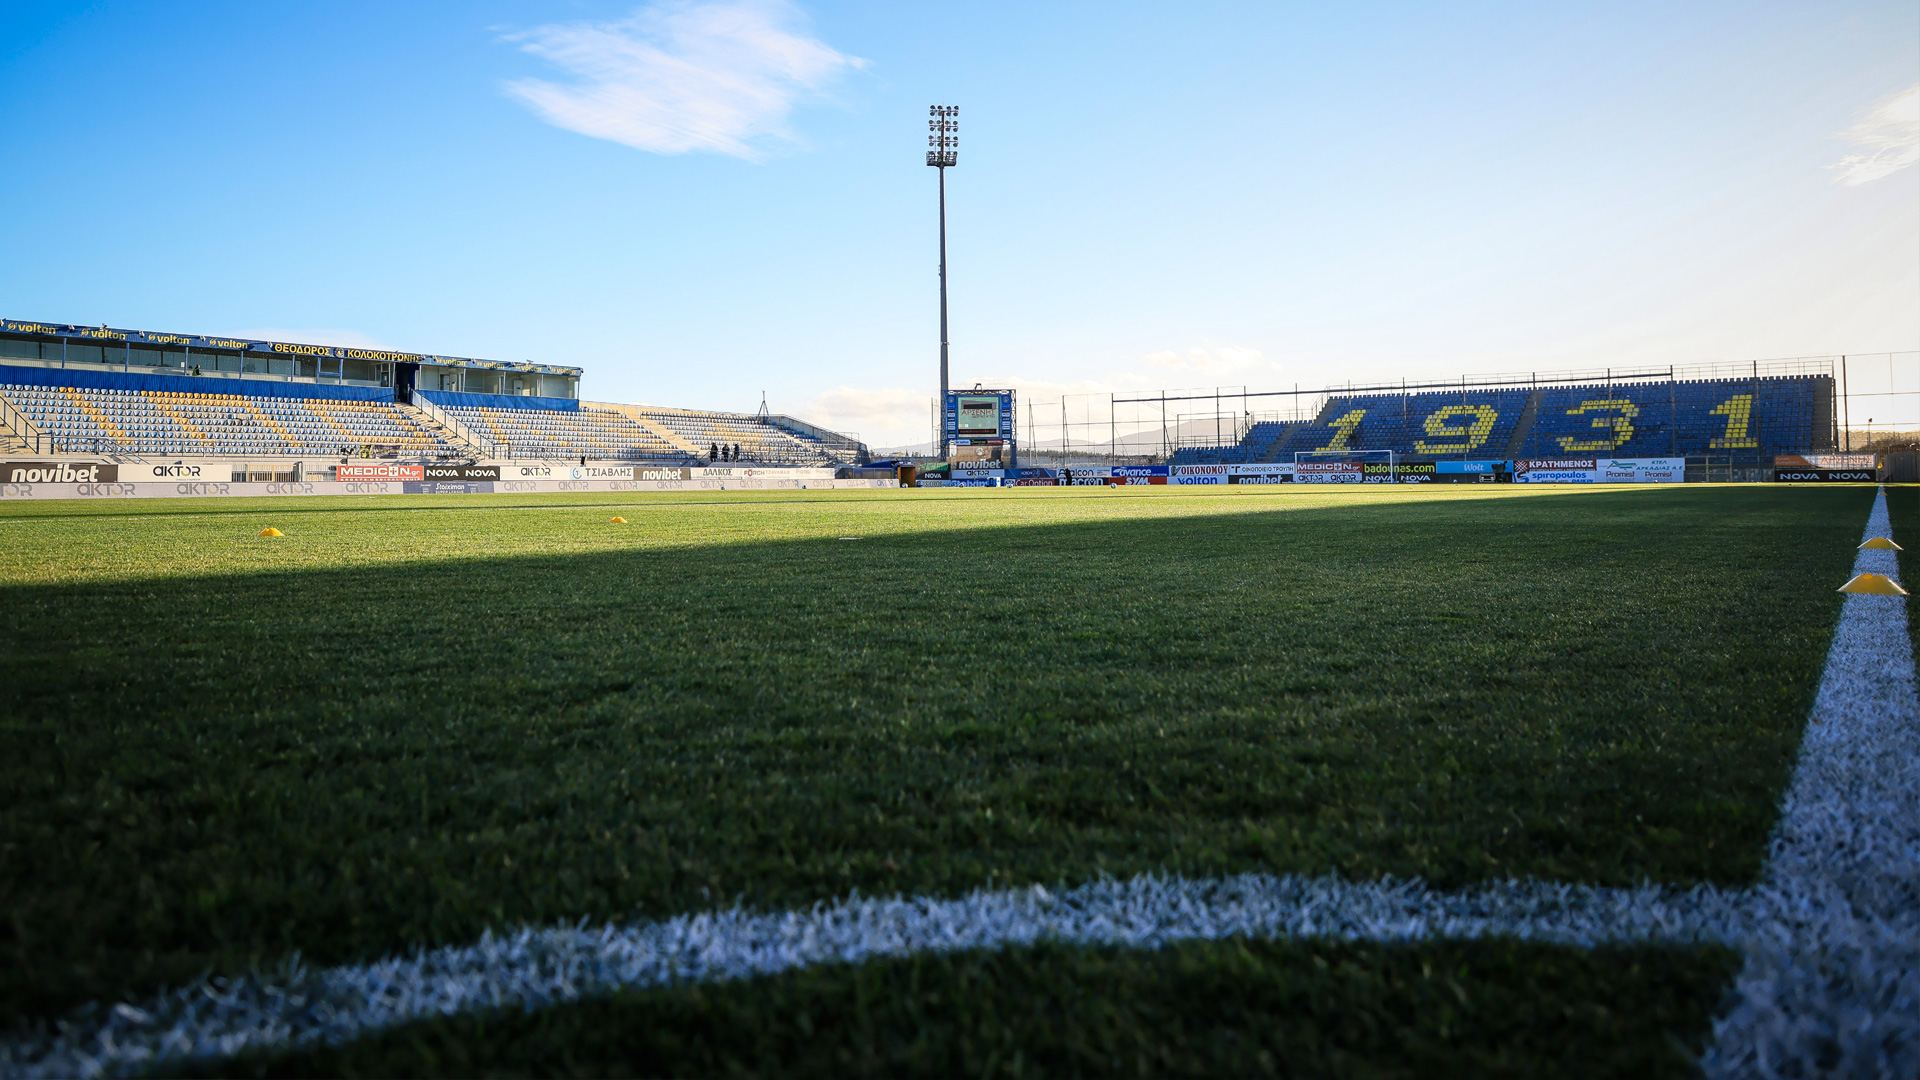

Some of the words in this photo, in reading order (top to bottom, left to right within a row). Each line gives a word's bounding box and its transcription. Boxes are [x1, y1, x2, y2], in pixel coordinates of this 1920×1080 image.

[18, 323, 57, 335] volton
[91, 330, 127, 341] volton
[157, 334, 190, 345] volton
[217, 339, 249, 349] volton
[274, 343, 331, 356] ΘΕΟΔΩΡΟΣ
[347, 349, 421, 363] ΚΟΛΟΚΟΤΡΩΝΗΣ
[958, 459, 1001, 469] novibet
[1529, 460, 1594, 468] ΚΡΑΤΗΜΕΝΟΣ
[11, 464, 99, 483] novibet
[427, 469, 459, 477] NOVA
[465, 469, 497, 477] NOVA
[585, 468, 632, 477] ΤΣΙΑΒΛΗΣ
[642, 467, 682, 480] novibet
[1532, 471, 1587, 480] spiropoulos
[1178, 477, 1217, 485] volton
[1239, 475, 1283, 484] novibet
[435, 482, 465, 490] Stoiximan
